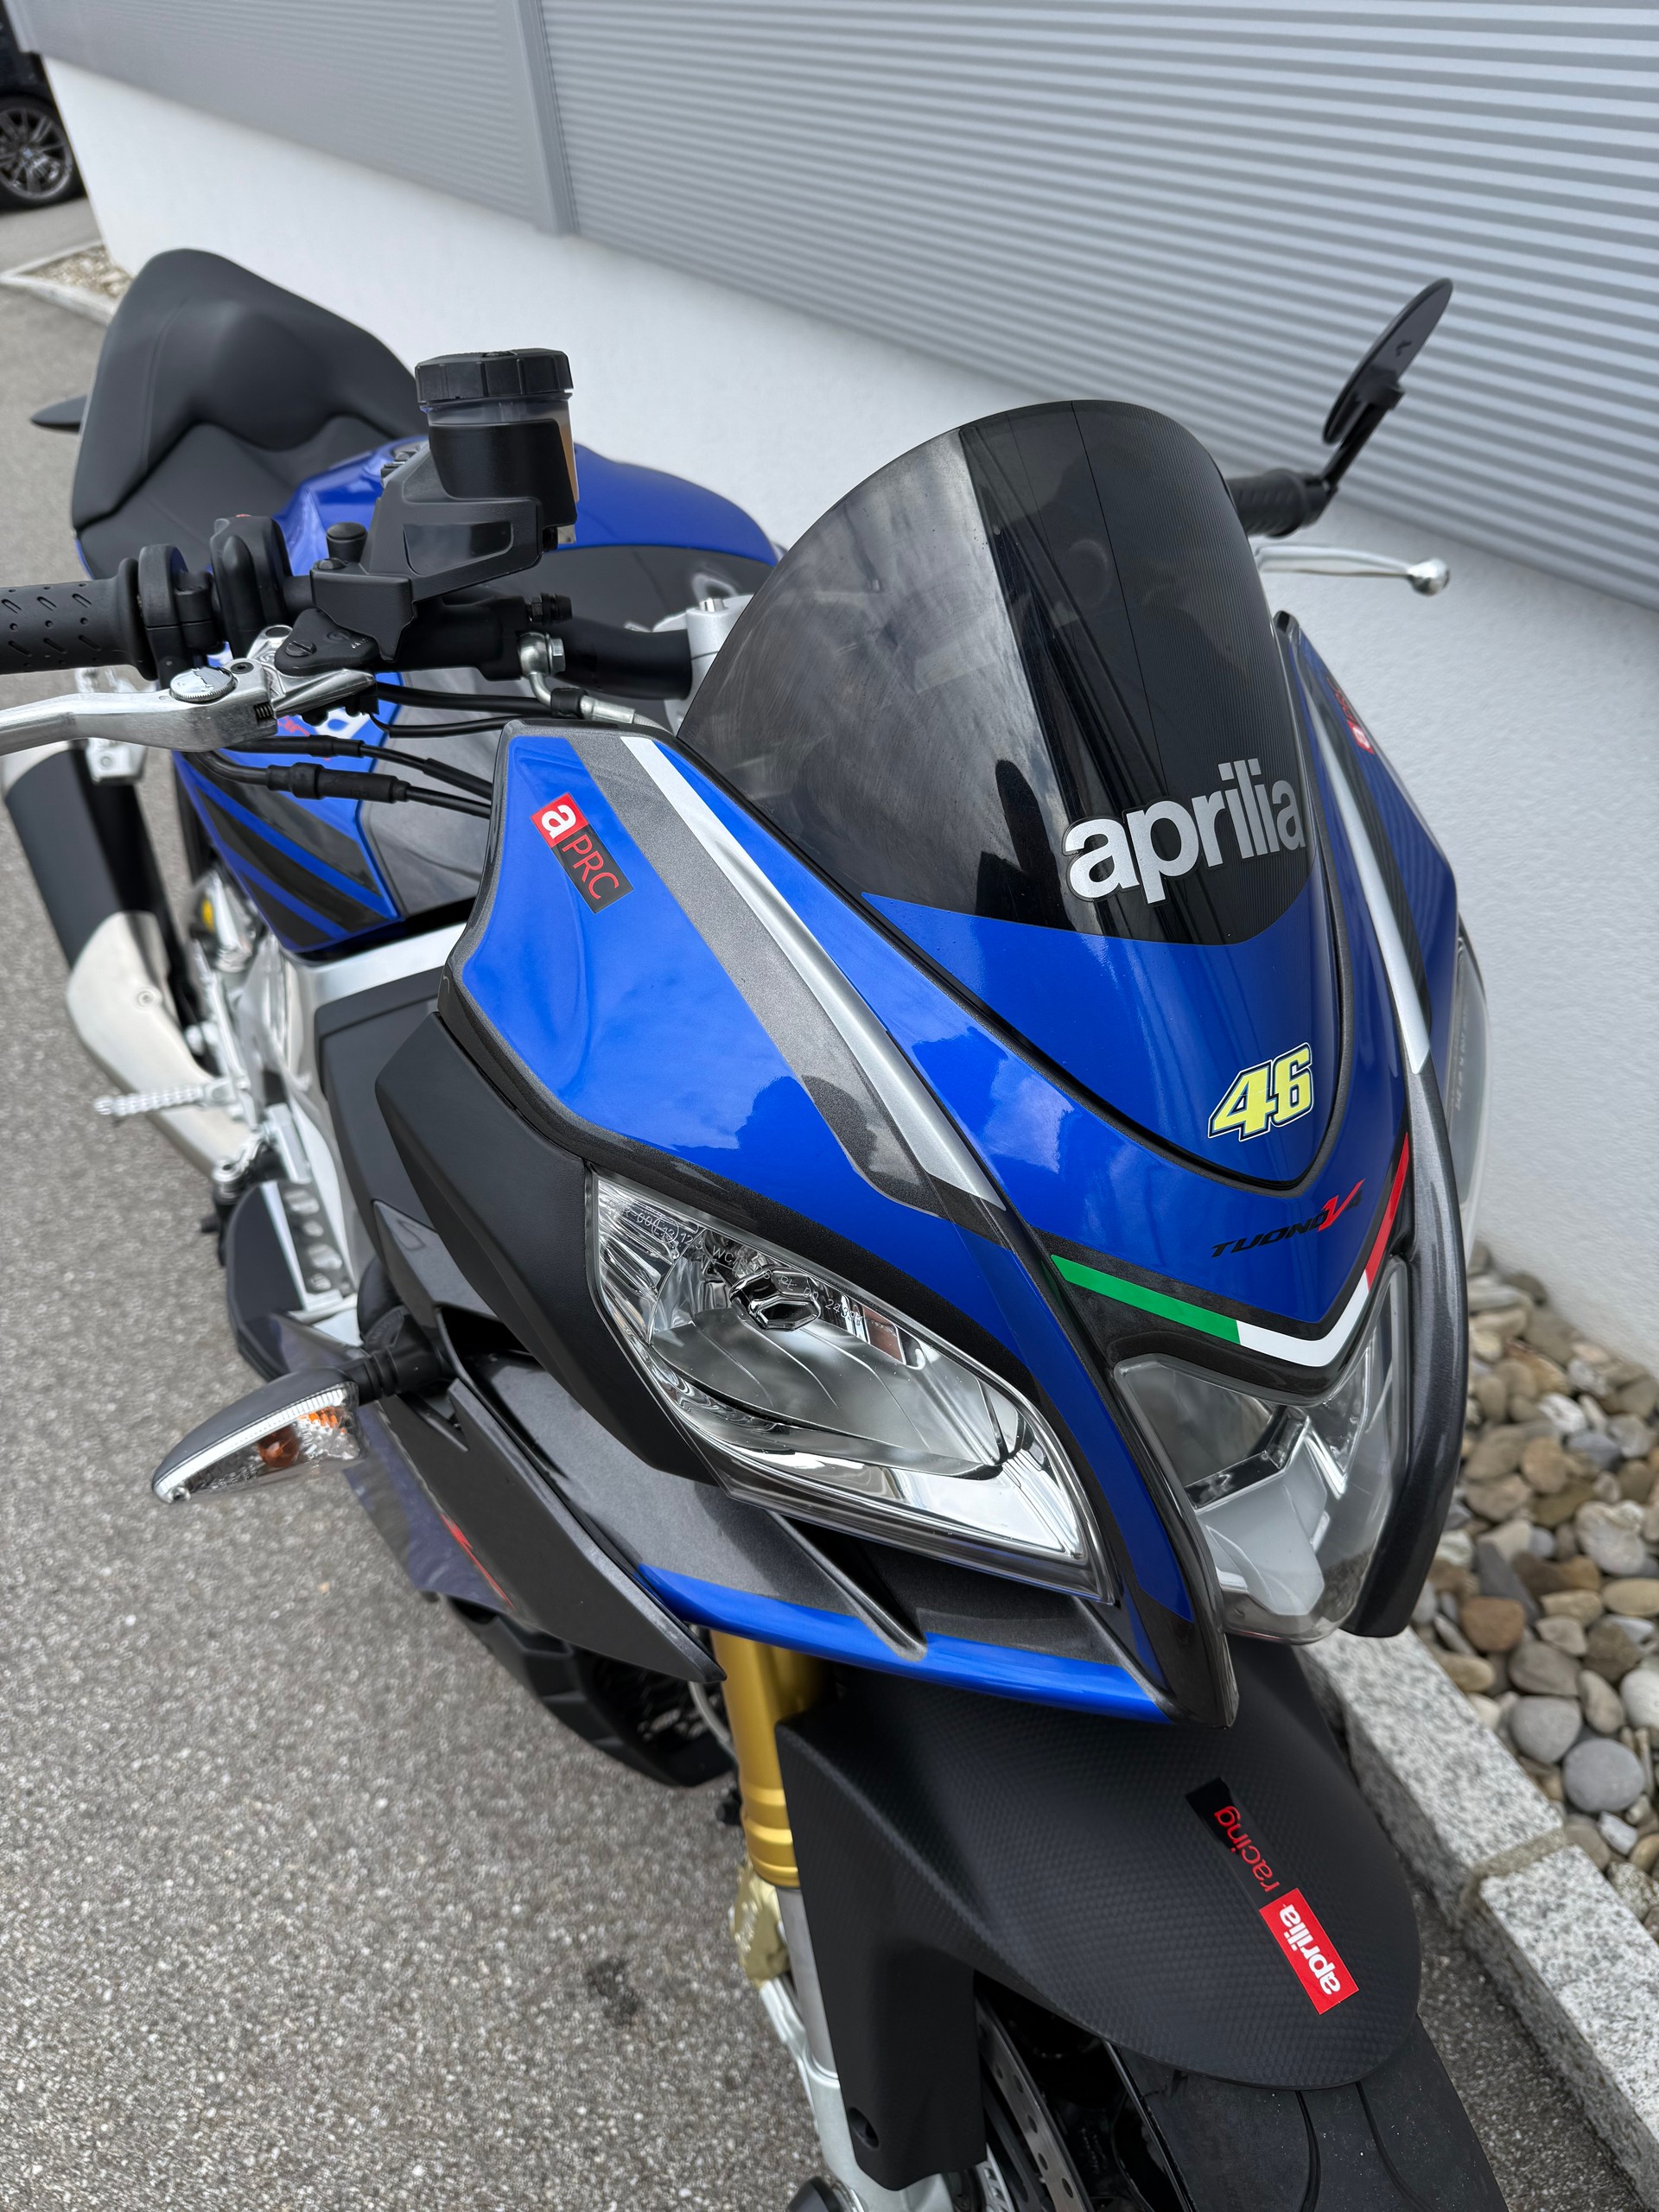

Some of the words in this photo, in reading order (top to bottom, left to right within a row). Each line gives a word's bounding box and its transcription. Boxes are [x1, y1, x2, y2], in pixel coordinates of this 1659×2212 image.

[1065, 758, 1306, 904] aprilia
[1209, 1043, 1313, 1141] 46
[1214, 1805, 1280, 1891] racing
[1279, 1904, 1341, 1995] aprilia
